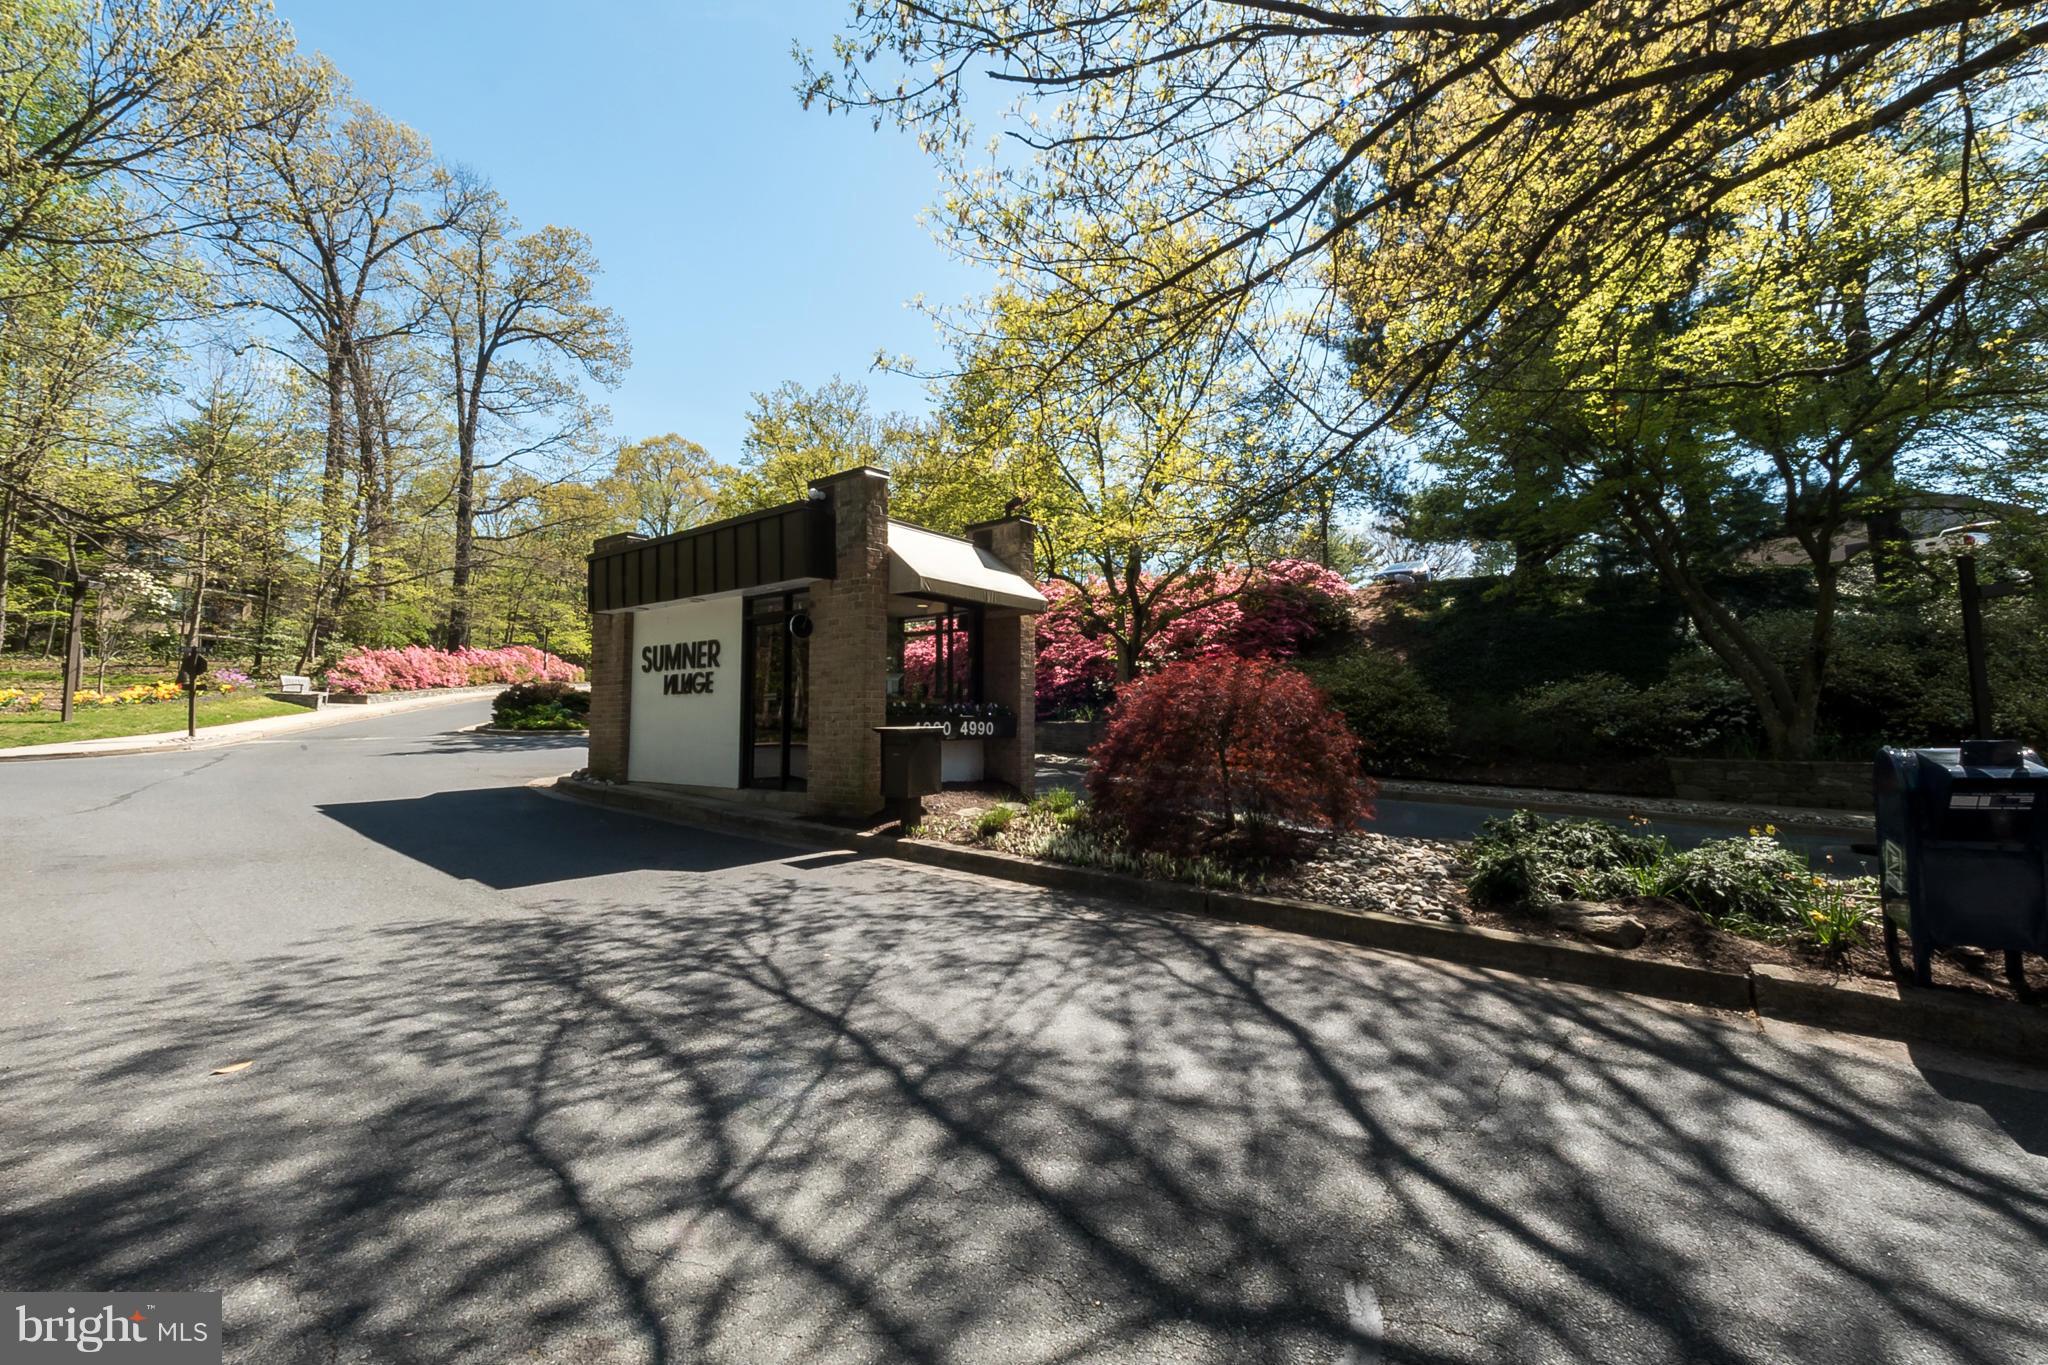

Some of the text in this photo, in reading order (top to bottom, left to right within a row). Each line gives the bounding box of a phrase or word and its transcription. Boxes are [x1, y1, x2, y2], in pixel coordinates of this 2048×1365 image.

[641, 639, 721, 673] SUMNER
[663, 671, 714, 695] VILLAGE
[960, 721, 994, 735] 4990
